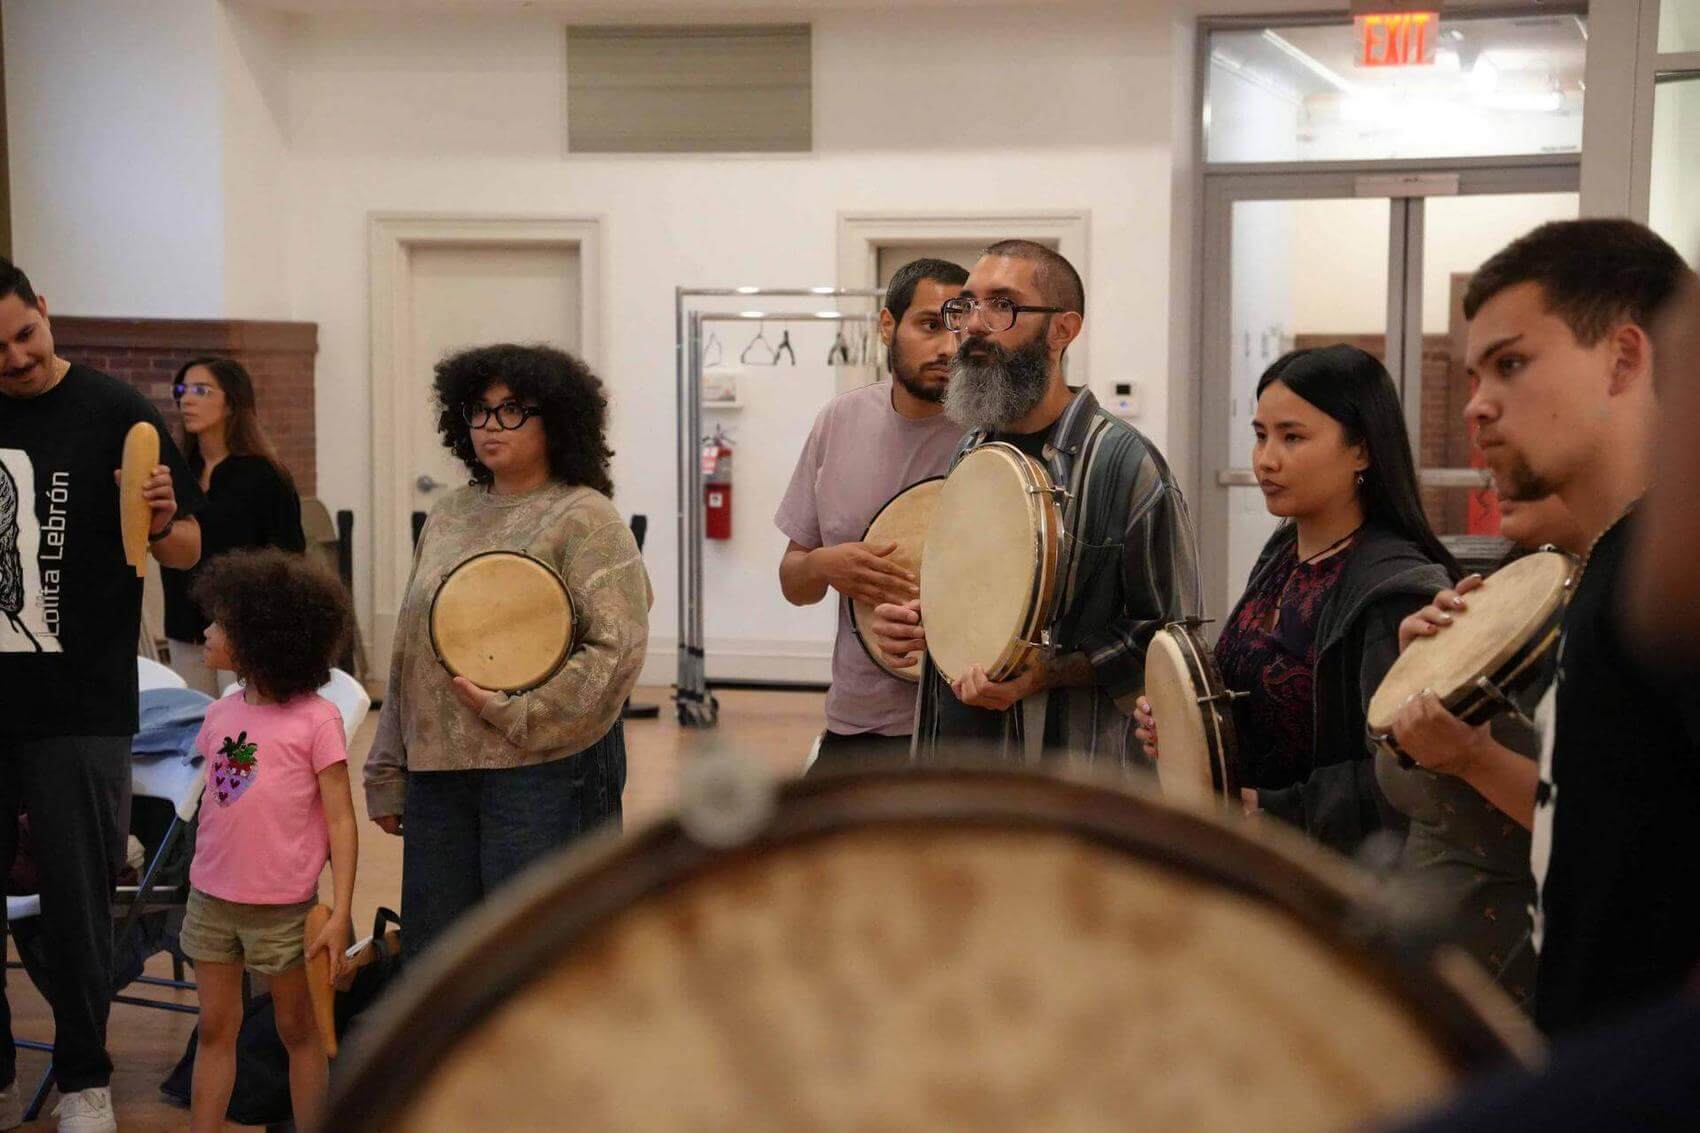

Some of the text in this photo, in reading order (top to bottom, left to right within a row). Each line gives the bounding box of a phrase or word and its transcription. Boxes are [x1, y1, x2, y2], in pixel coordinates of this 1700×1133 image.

[1364, 13, 1431, 65] EXIT
[36, 472, 70, 637] Lolita Lebrón
